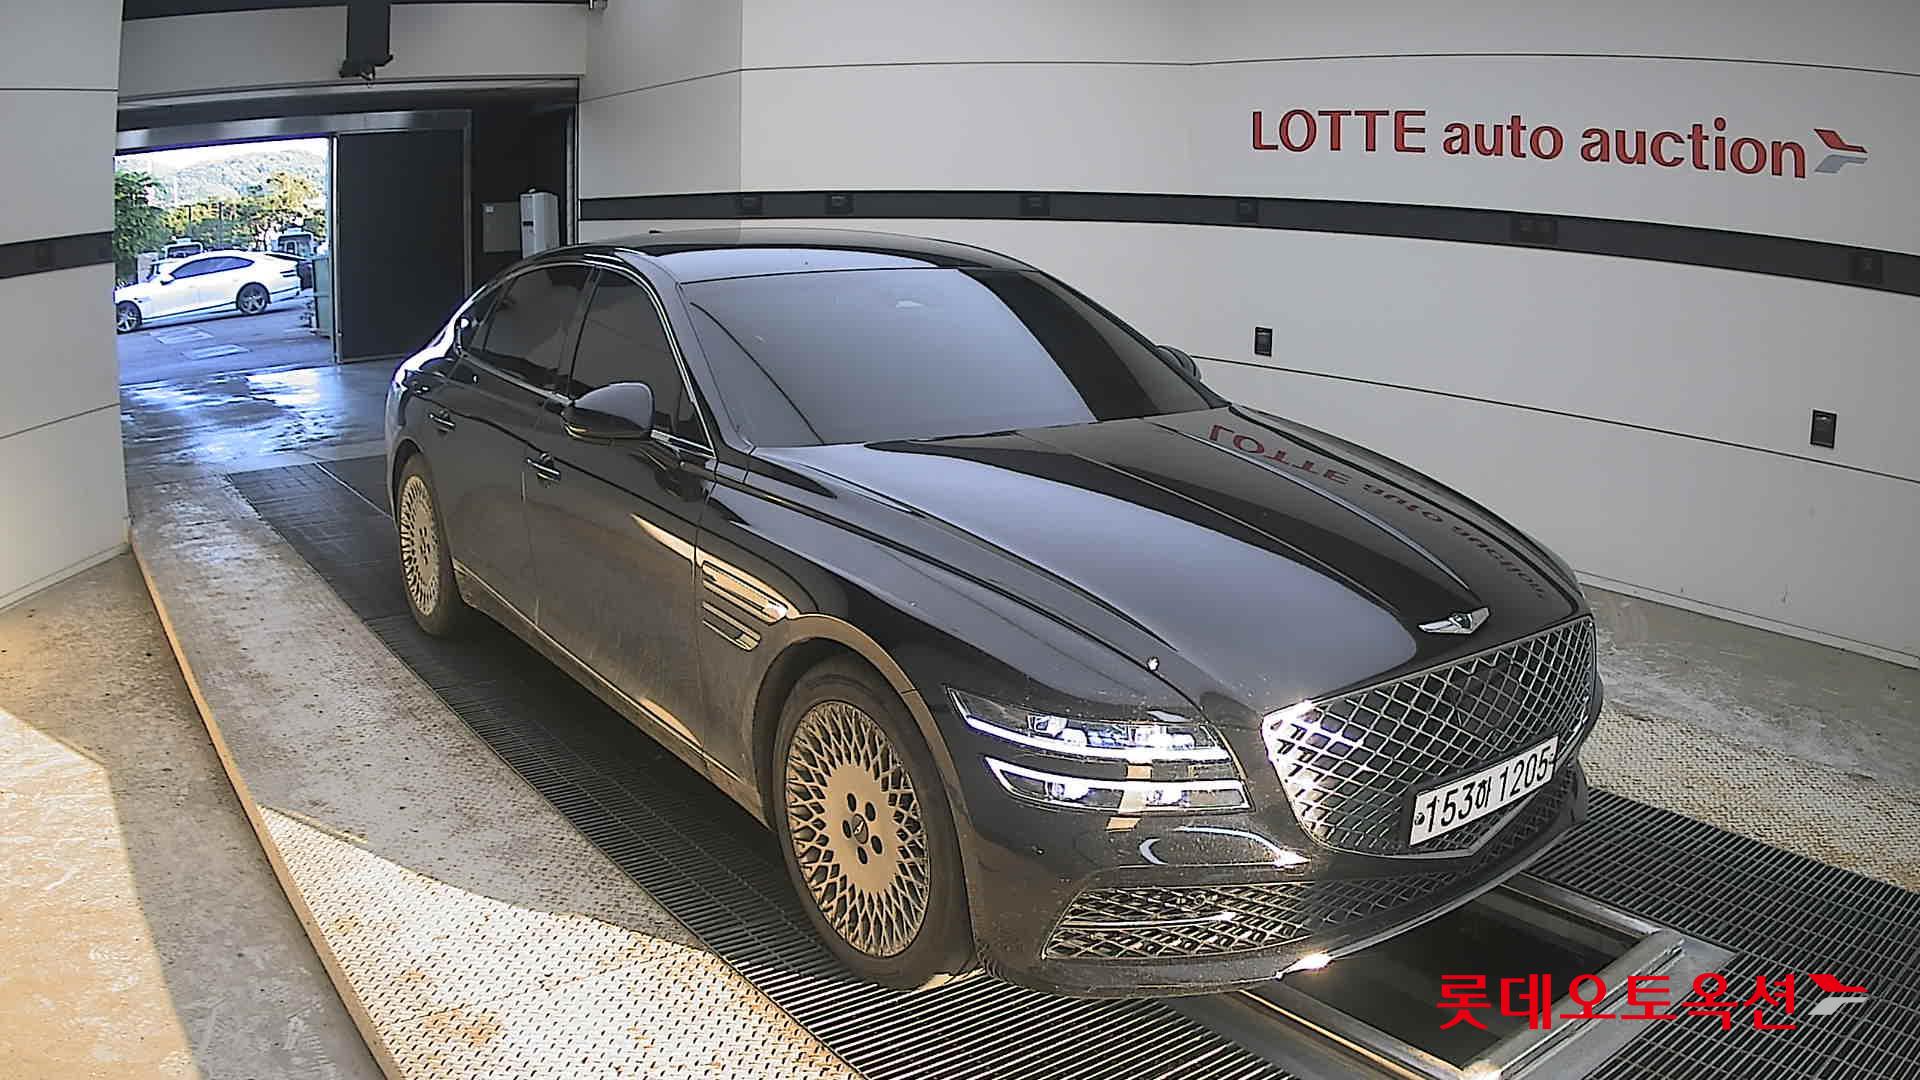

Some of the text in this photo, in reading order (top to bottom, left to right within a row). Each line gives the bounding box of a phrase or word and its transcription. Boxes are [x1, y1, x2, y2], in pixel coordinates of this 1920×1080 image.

[1252, 110, 1807, 178] LOTTE auto auction
[1426, 745, 1552, 833] 153하 1205
